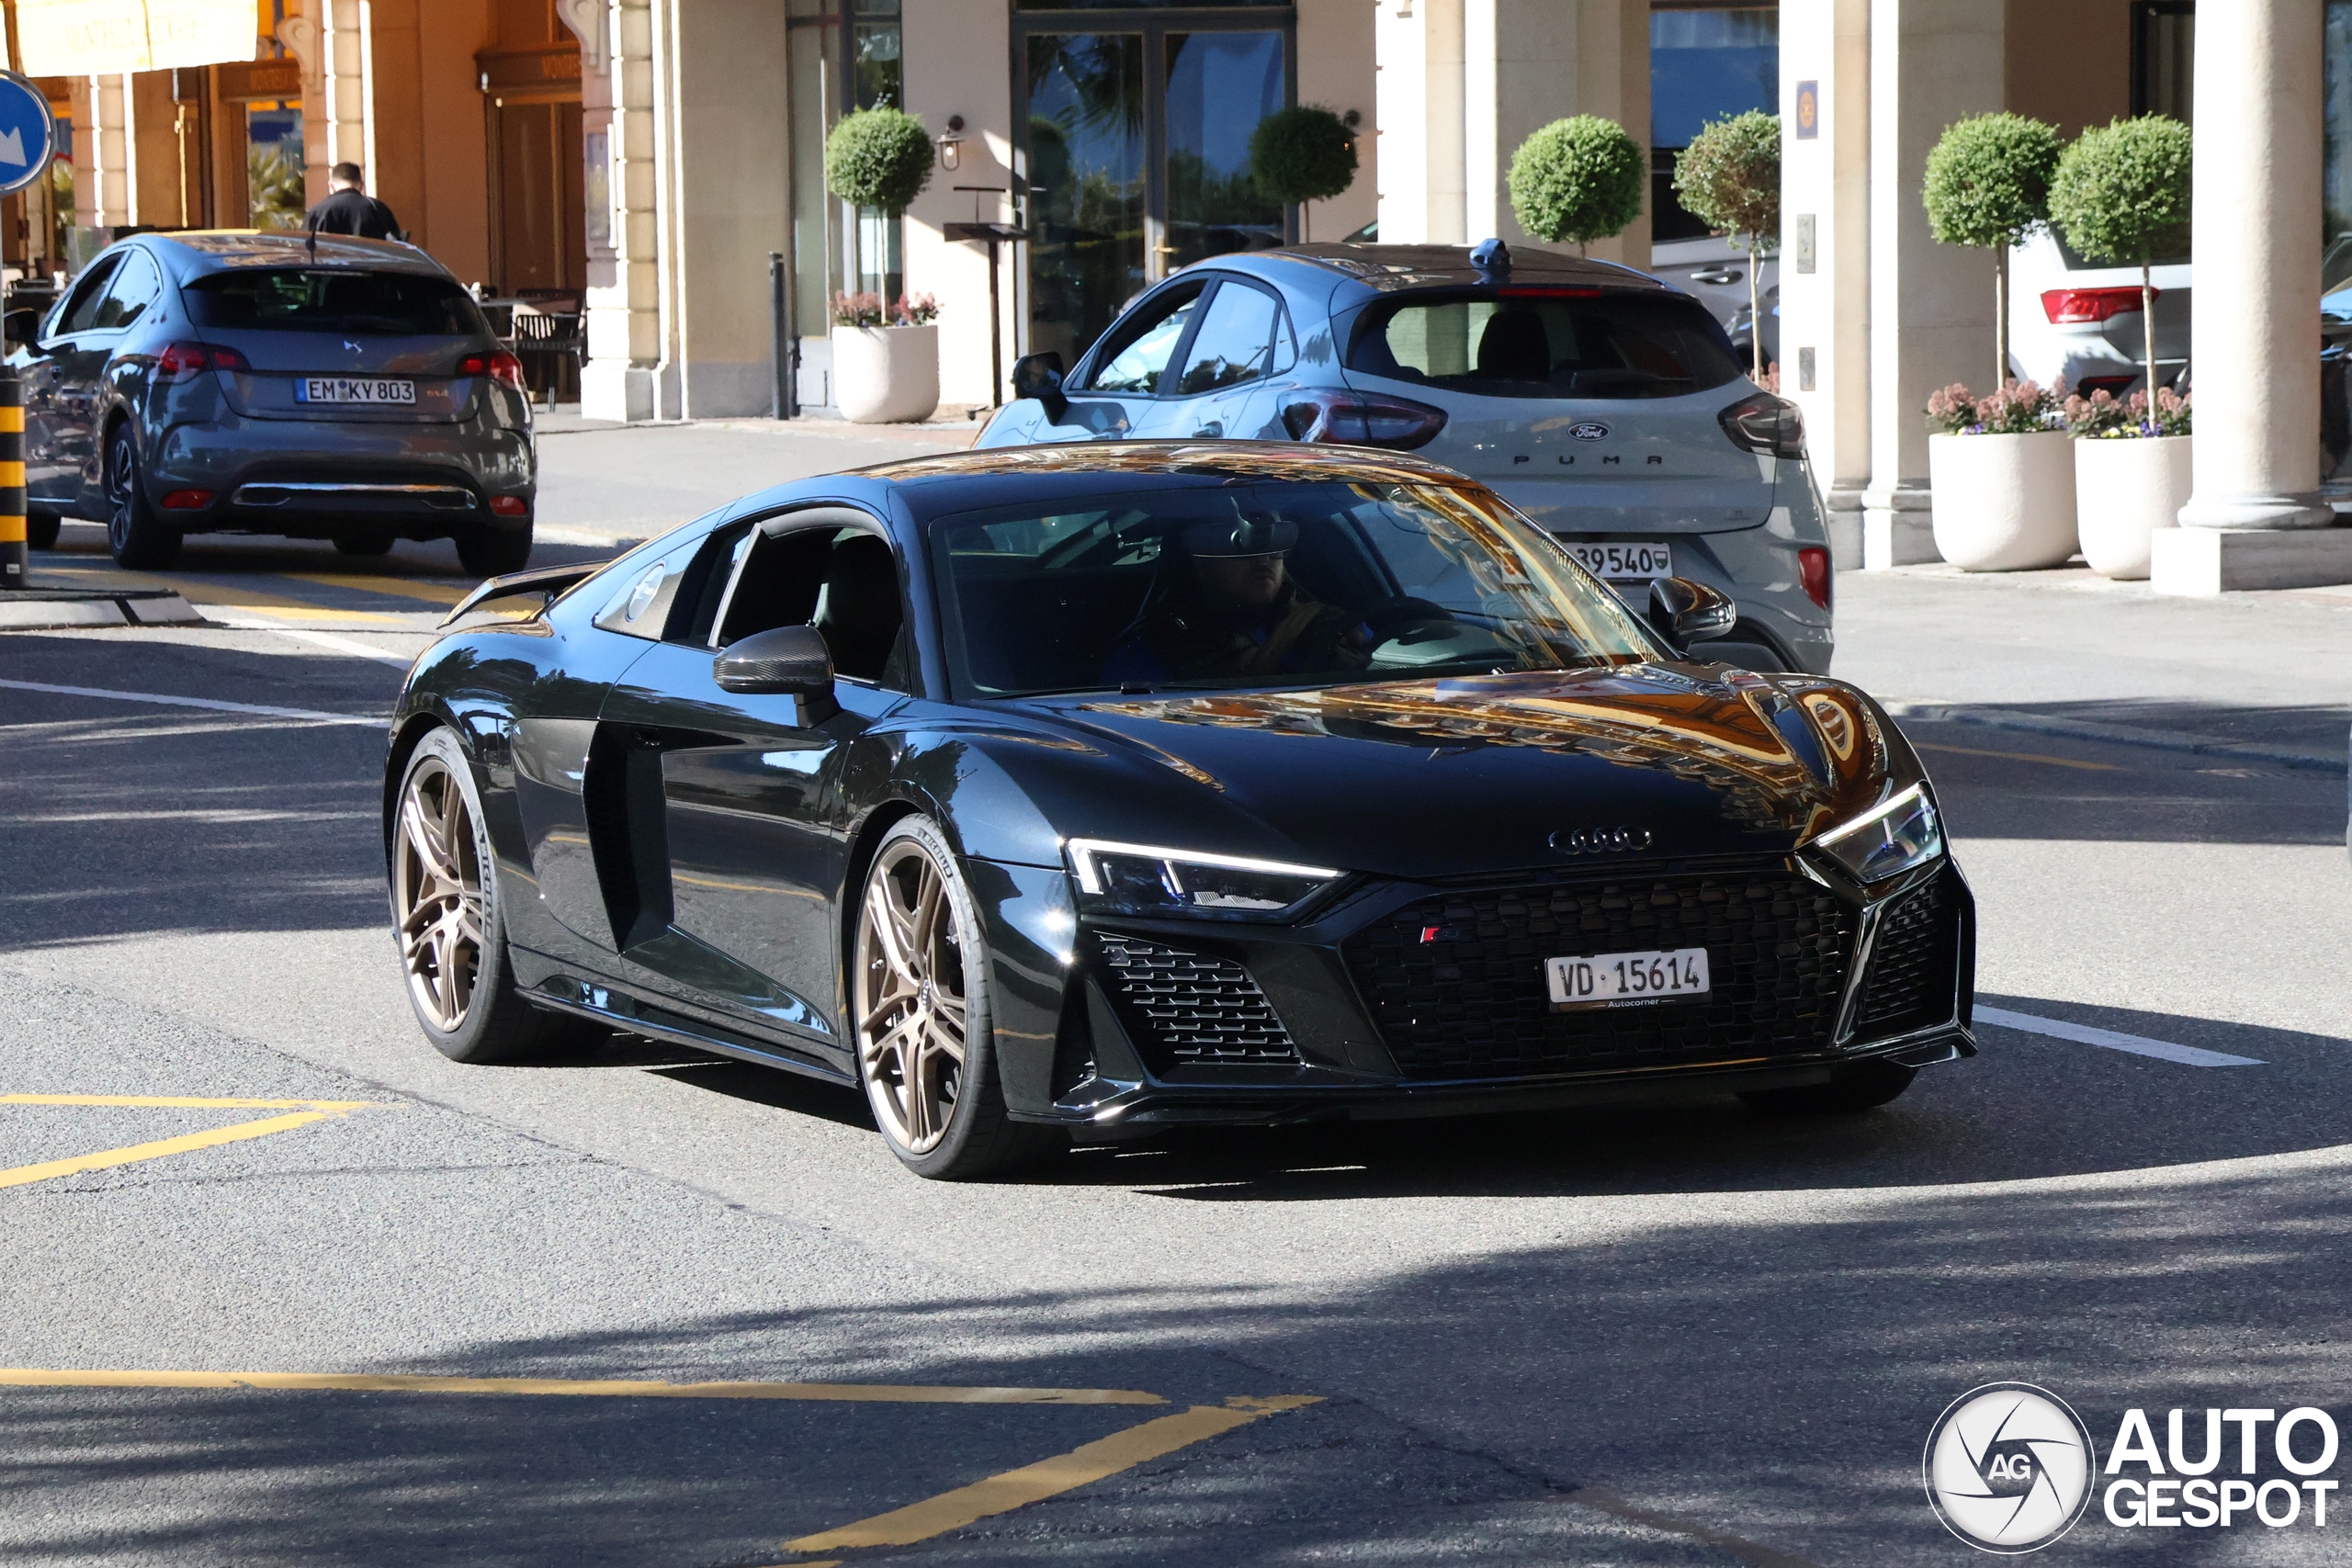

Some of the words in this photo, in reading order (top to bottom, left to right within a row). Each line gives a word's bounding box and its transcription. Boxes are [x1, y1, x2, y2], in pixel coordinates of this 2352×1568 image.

[309, 381, 335, 400] EM
[348, 382, 372, 400] KY
[378, 382, 413, 400] 803
[1576, 425, 1603, 438] Ford
[1514, 456, 1662, 464] PUMA
[1559, 964, 1594, 997] VD
[1615, 956, 1700, 993] 15614
[1607, 998, 1660, 1009] Autocorner
